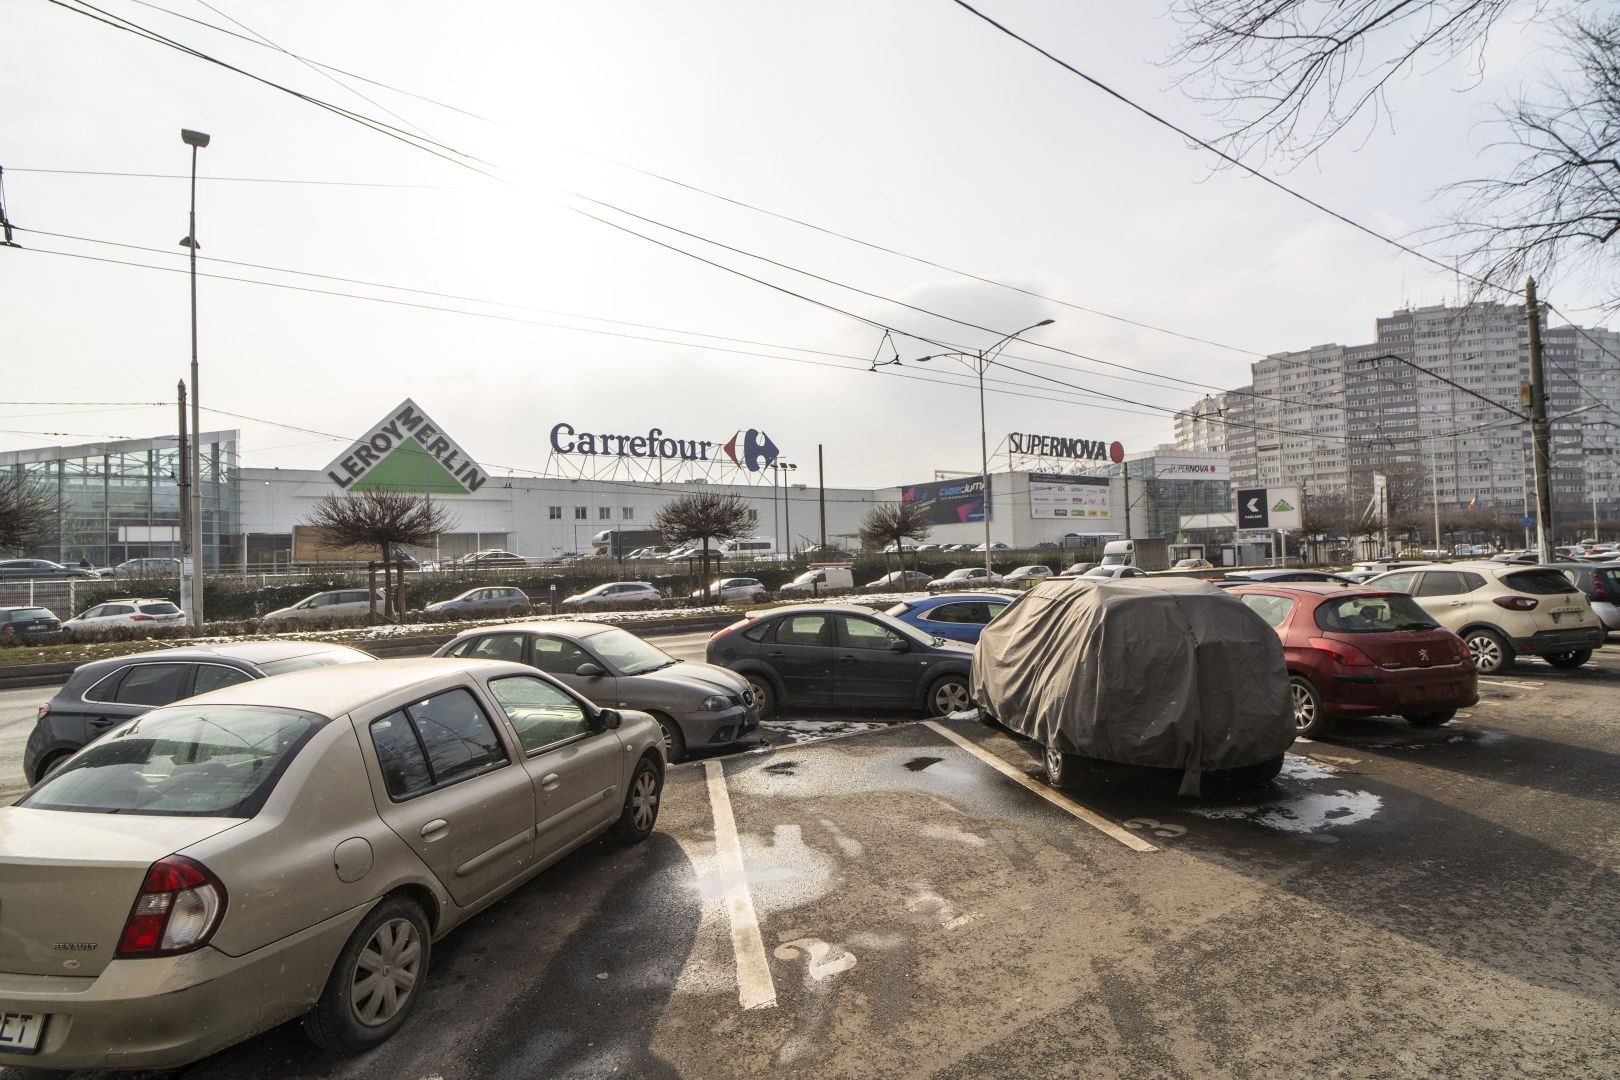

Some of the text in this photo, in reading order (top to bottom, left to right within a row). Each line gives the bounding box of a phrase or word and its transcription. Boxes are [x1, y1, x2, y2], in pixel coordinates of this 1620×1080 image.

[328, 405, 487, 492] LEROY MERLIN
[550, 423, 712, 460] Carrefour
[1009, 432, 1107, 461] SUPERNOVA
[53, 943, 98, 951] RENAULT
[774, 937, 857, 981] 2
[0, 1012, 33, 1044] ET
